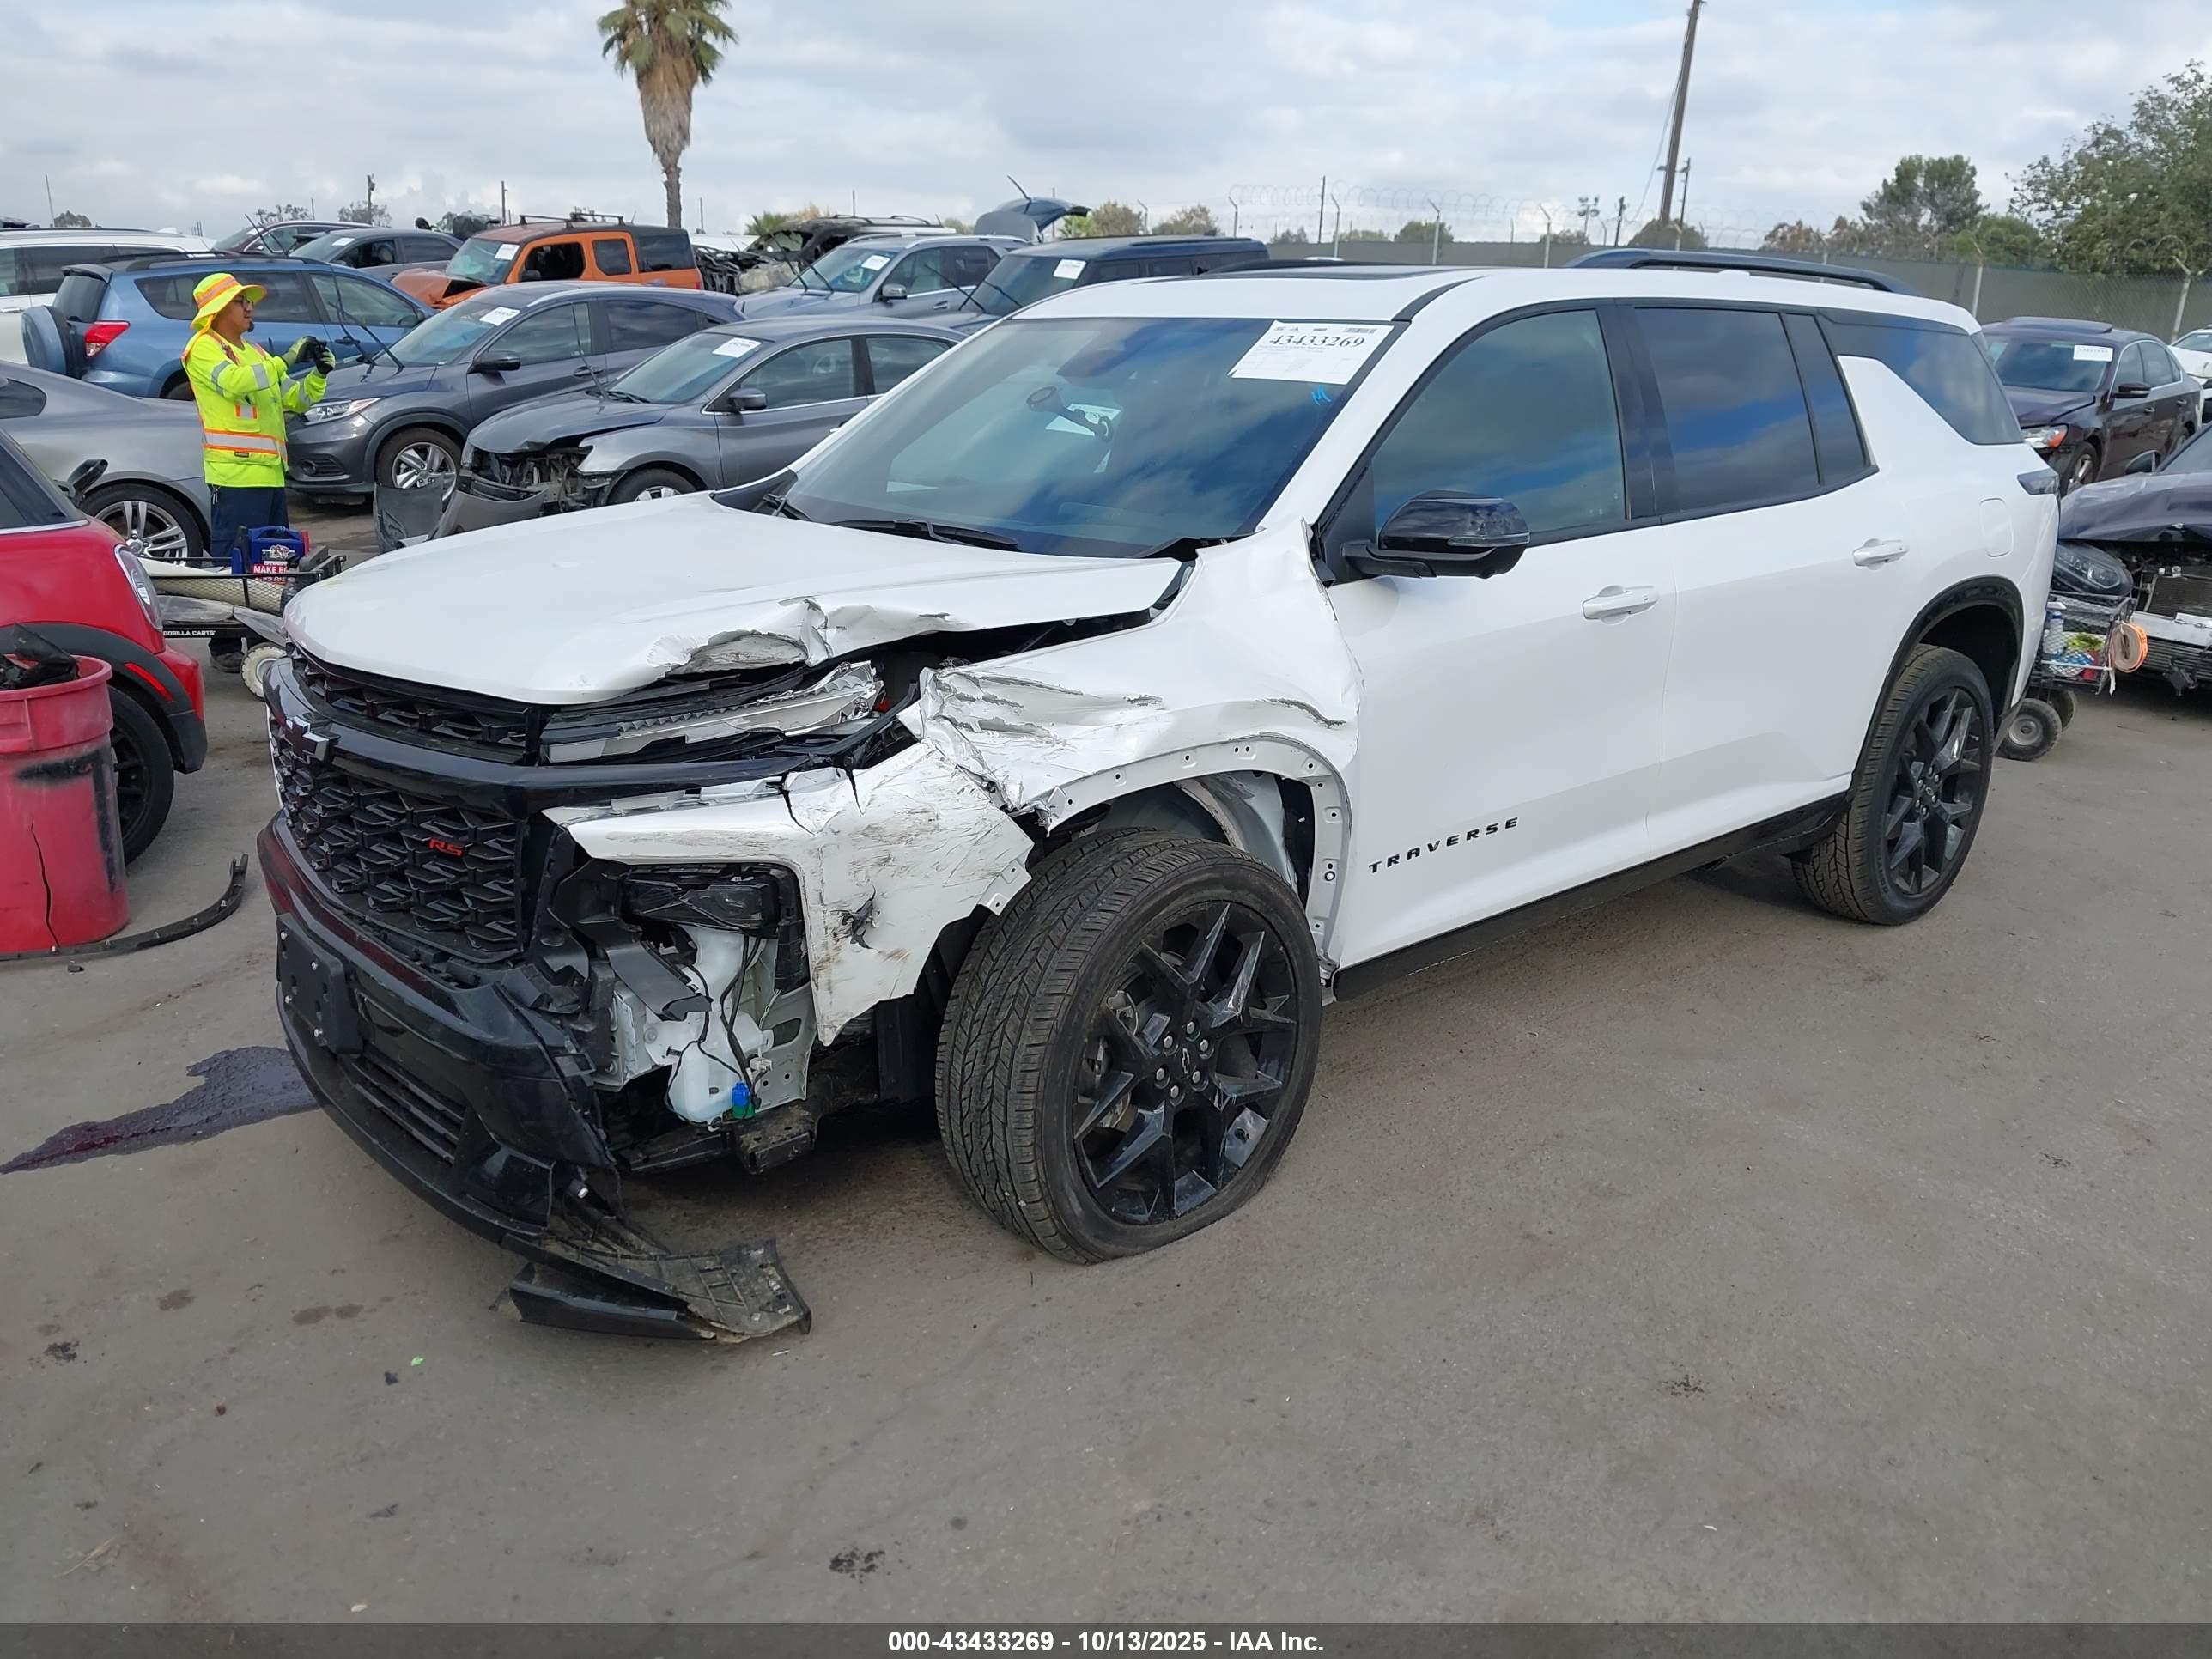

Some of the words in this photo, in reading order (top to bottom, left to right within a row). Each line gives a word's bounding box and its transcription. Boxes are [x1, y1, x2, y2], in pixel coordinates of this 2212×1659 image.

[1269, 334, 1365, 347] 43433269
[253, 565, 277, 574] MAKE
[428, 838, 463, 856] RS
[1368, 817, 1518, 873] TRAVERSE
